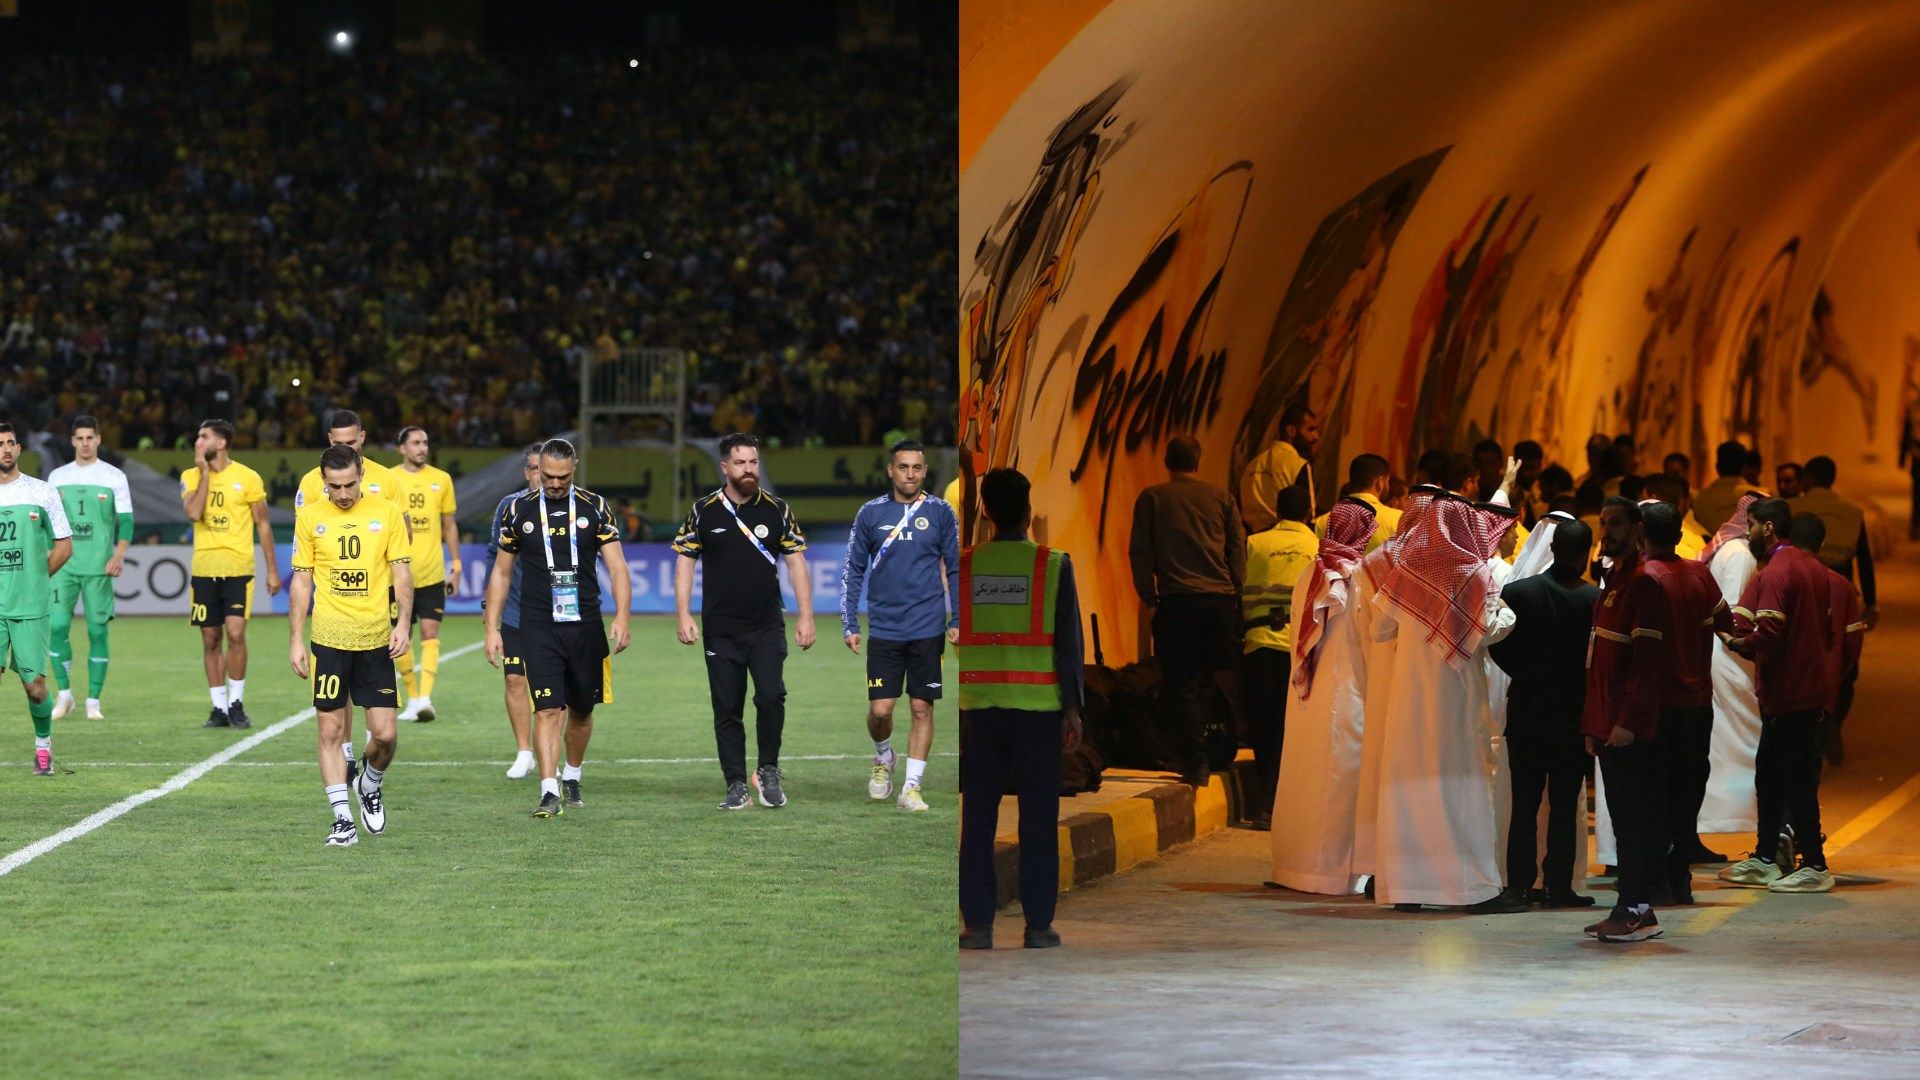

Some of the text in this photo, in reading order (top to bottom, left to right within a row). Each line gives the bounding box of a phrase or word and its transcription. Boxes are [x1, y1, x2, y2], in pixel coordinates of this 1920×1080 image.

[211, 491, 224, 508] 70
[409, 493, 425, 509] 99
[78, 500, 85, 515] 1
[0, 521, 17, 542] 22
[549, 527, 566, 536] P.S
[898, 531, 913, 541] A.K
[338, 535, 361, 560] 10
[53, 589, 60, 603] 1
[192, 603, 207, 622] 70
[316, 674, 340, 700] 10
[868, 678, 883, 688] A.K
[535, 688, 552, 699] P.S
